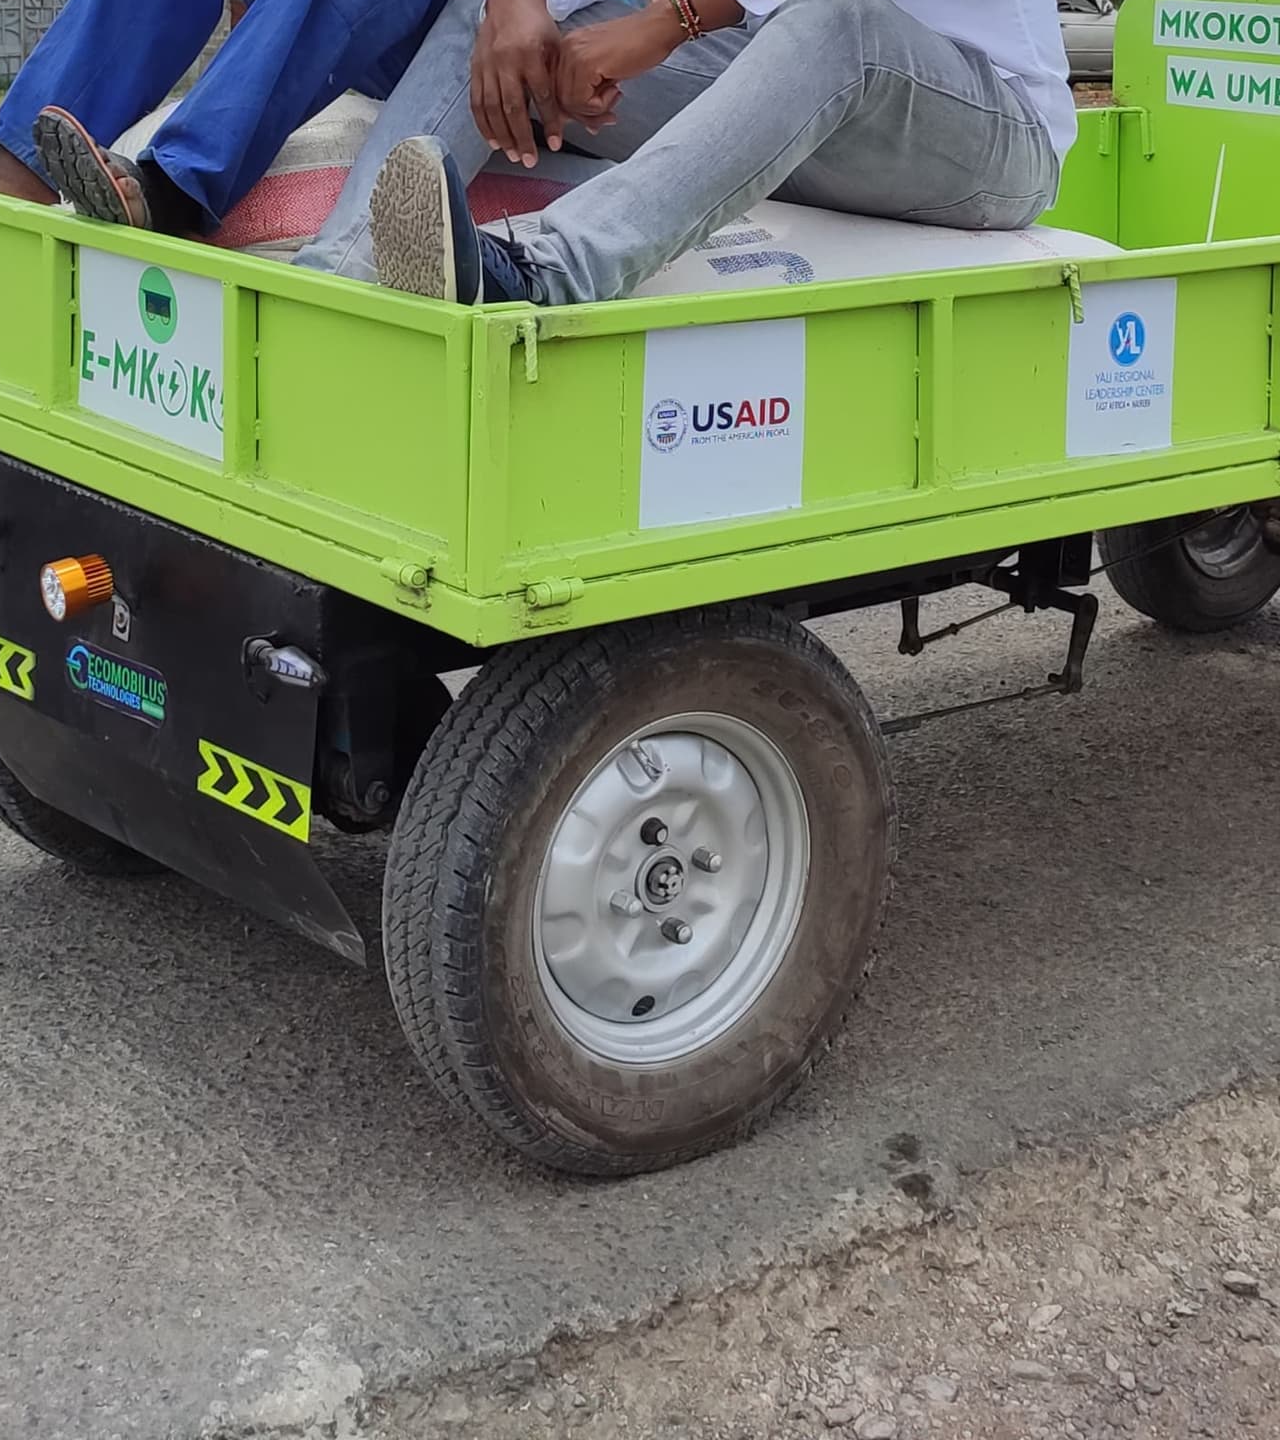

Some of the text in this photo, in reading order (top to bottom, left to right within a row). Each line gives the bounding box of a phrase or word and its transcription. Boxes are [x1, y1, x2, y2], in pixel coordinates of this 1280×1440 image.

[1169, 66, 1216, 100] WA
[1085, 383, 1165, 401] LEADERSHIP CENTER
[1114, 369, 1155, 383] REGIONAL
[692, 397, 791, 433] USAID
[691, 427, 790, 446] FROM THE AMERICAN PEOPLE
[87, 652, 166, 706] ECOMOBILUS
[87, 675, 142, 711] TECHNOLOGIES
